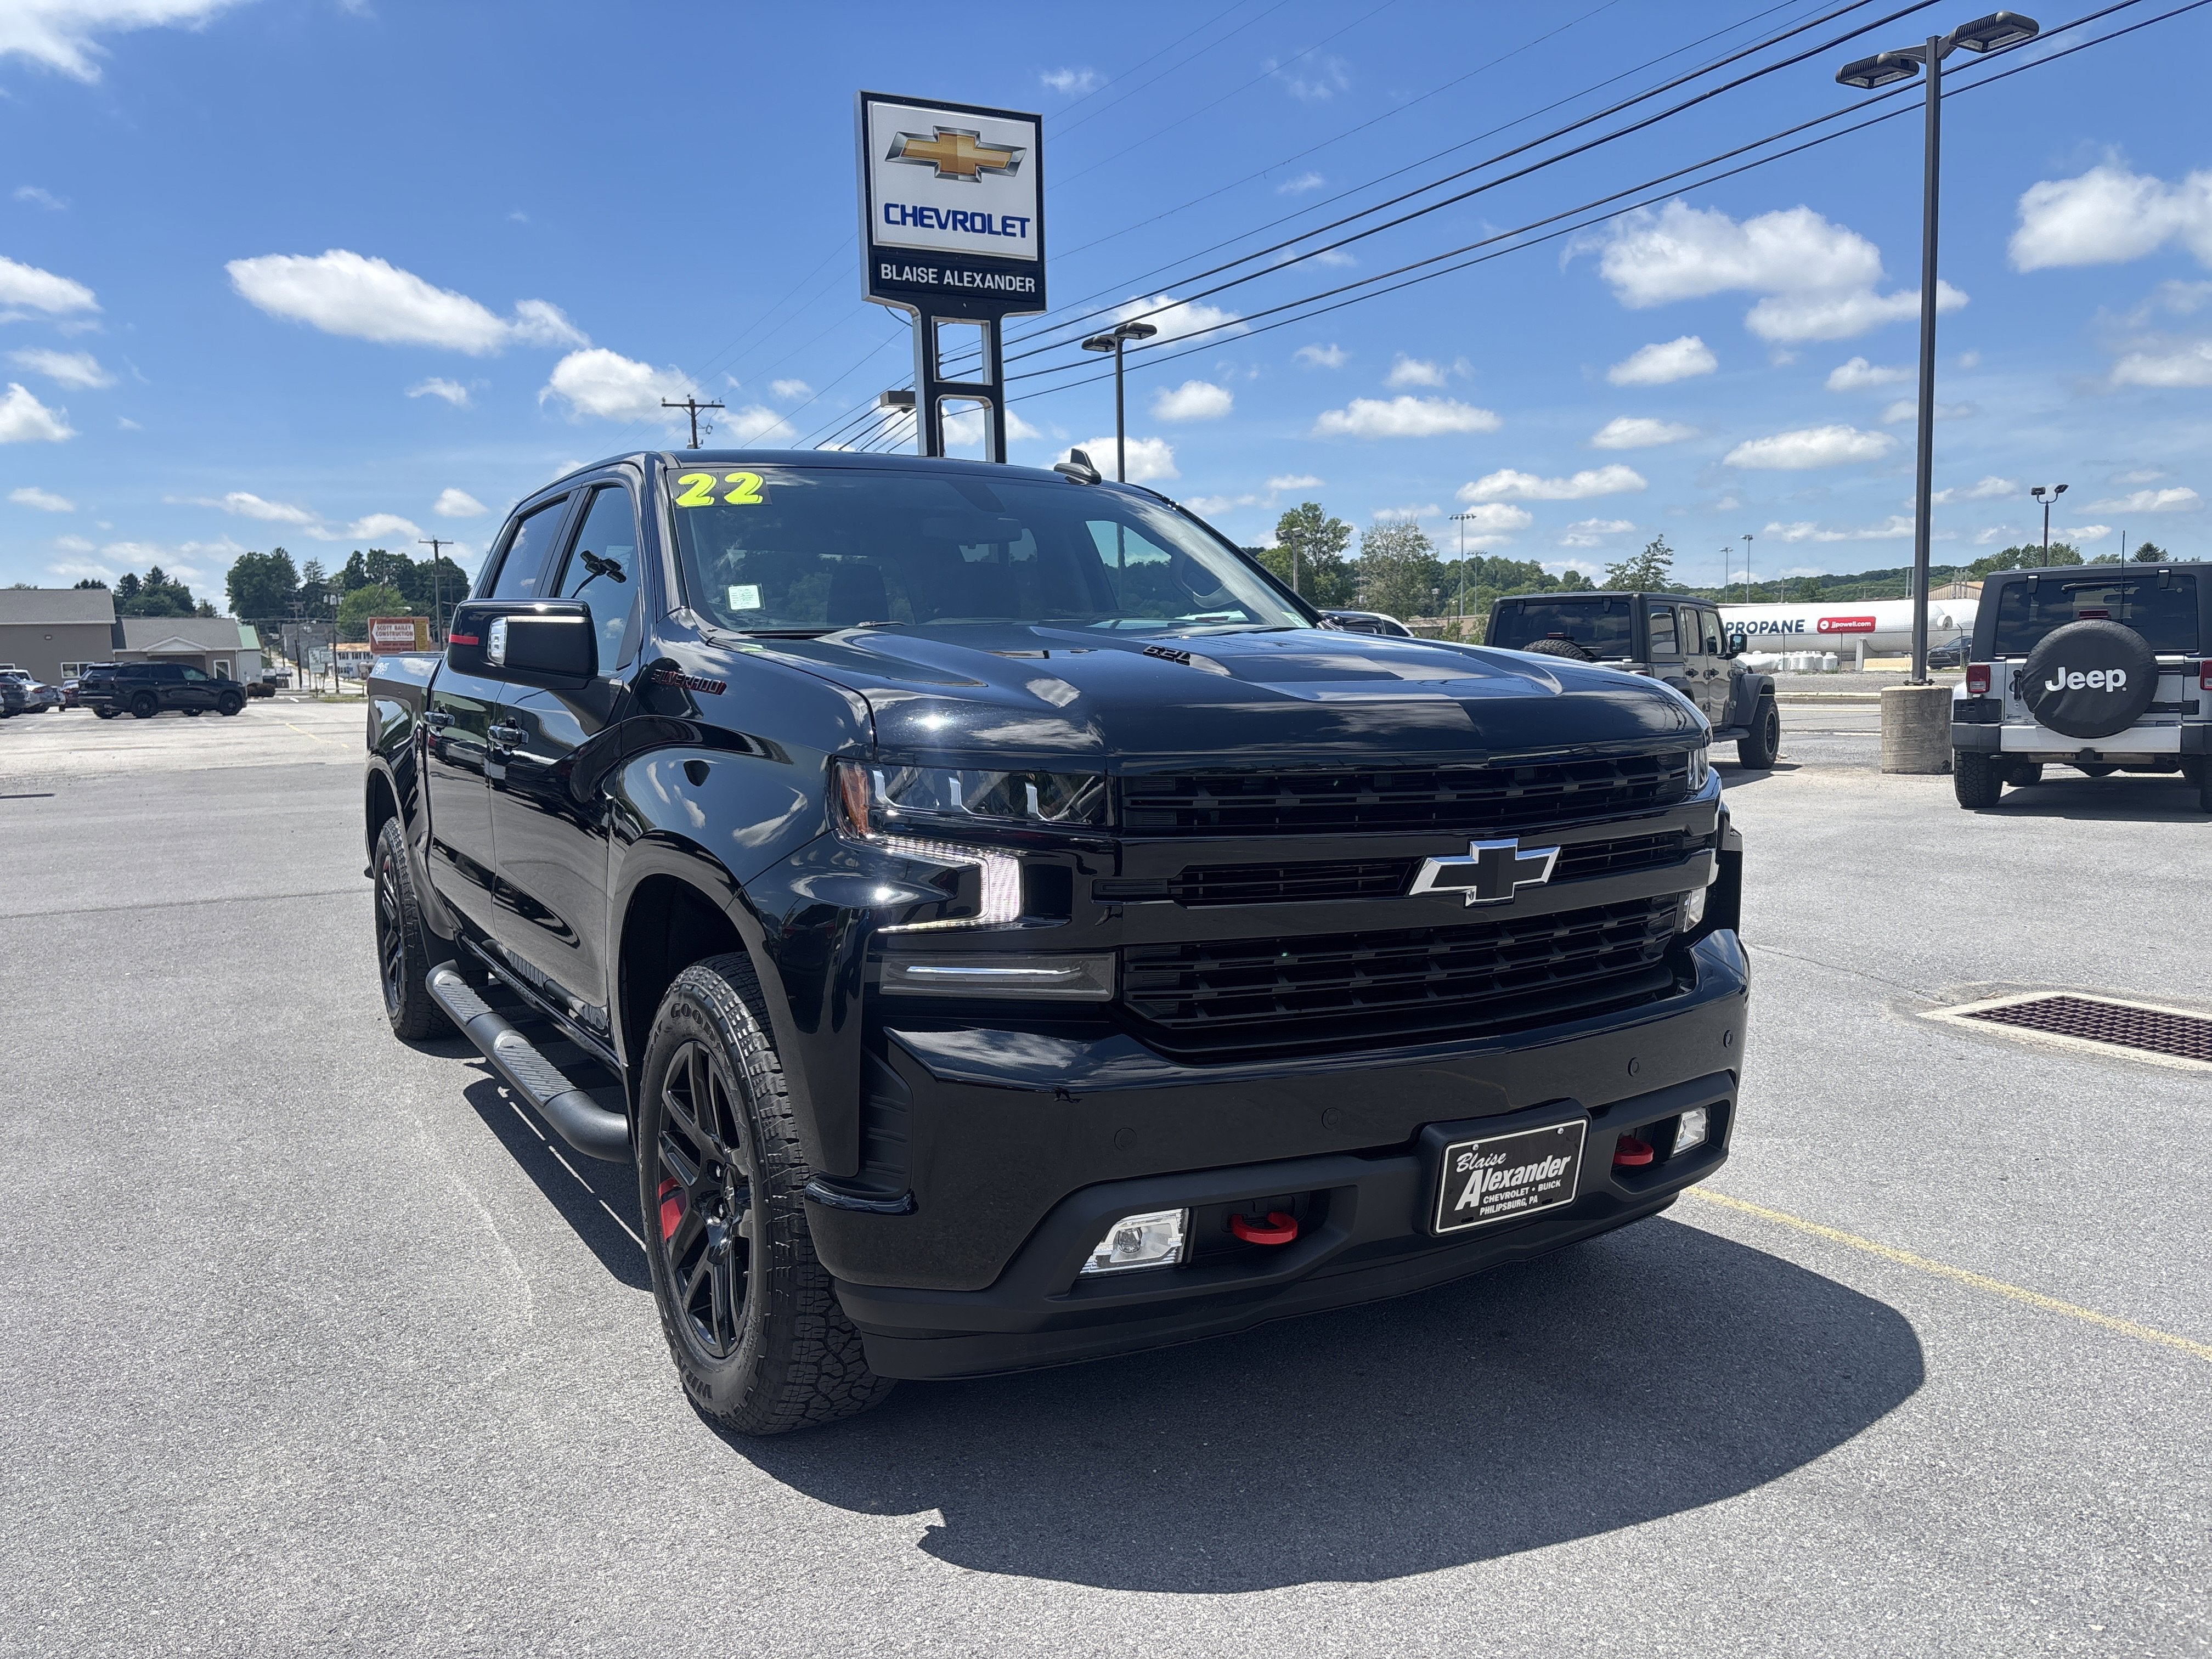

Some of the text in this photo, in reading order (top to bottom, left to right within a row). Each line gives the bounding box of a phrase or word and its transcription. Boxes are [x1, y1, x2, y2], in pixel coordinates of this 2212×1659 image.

[884, 202, 1030, 238] CHEVROLET
[881, 263, 1035, 293] BLAISE ALEXANDER
[675, 471, 764, 507] 22
[1725, 619, 1805, 634] PROPANE
[651, 669, 727, 695] SILVERADO
[2045, 667, 2126, 692] Jeep
[1456, 1152, 1506, 1172] Blaise
[1454, 1155, 1572, 1211] Alexander
[1483, 1180, 1561, 1204] CHEVROLET BUICK
[1480, 1195, 1538, 1216] PHILIPSBURG, PA
